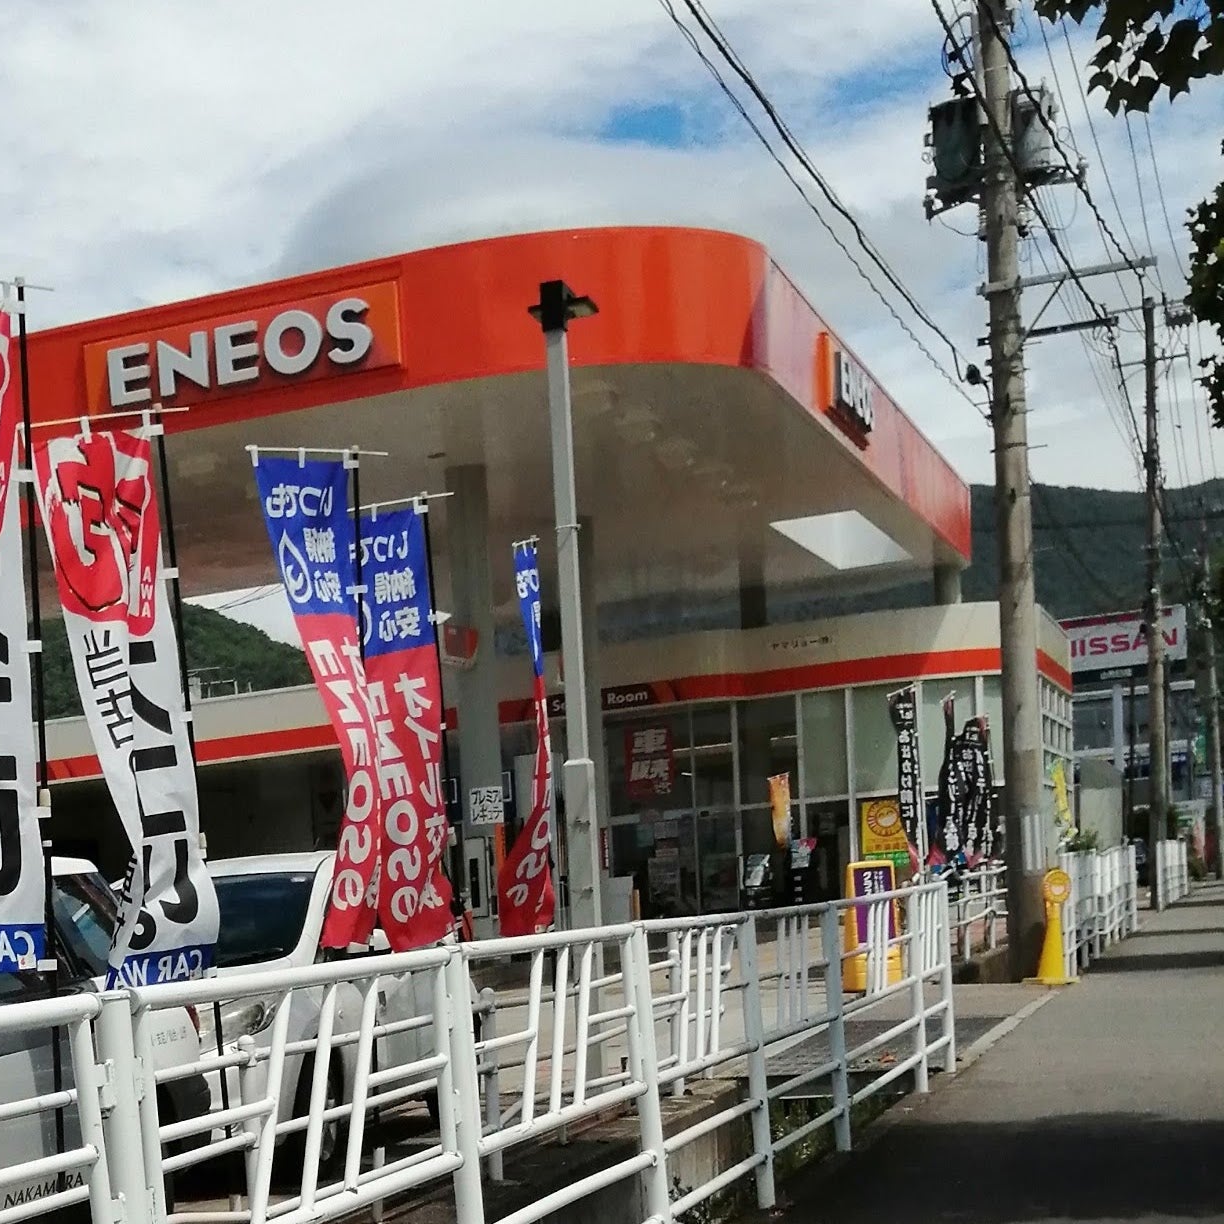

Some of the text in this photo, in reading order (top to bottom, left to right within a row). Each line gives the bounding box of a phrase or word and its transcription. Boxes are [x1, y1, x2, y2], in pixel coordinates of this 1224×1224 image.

[107, 298, 373, 407] ENEOS
[607, 689, 648, 705] Room
[4, 1171, 85, 1208] NAKAMRA
